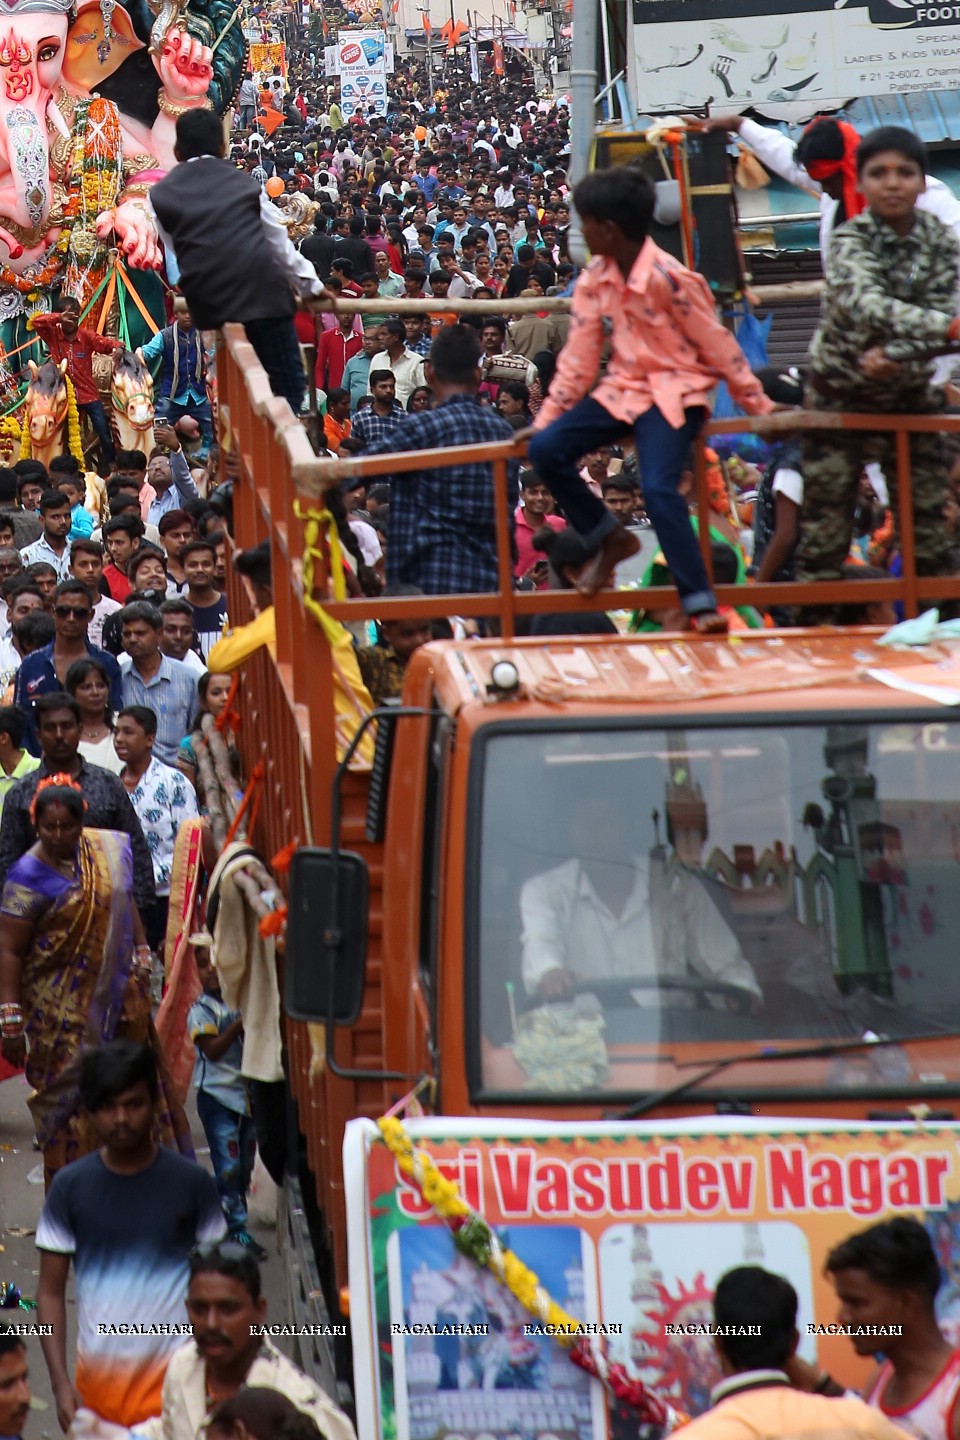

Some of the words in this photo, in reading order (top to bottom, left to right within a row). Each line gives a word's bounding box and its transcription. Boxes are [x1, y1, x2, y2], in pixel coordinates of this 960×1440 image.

[844, 54, 883, 64] LADIES
[887, 51, 897, 61] &
[901, 50, 928, 59] KIDS
[489, 1145, 755, 1217] Vasudev
[764, 1142, 951, 1217] Nagar
